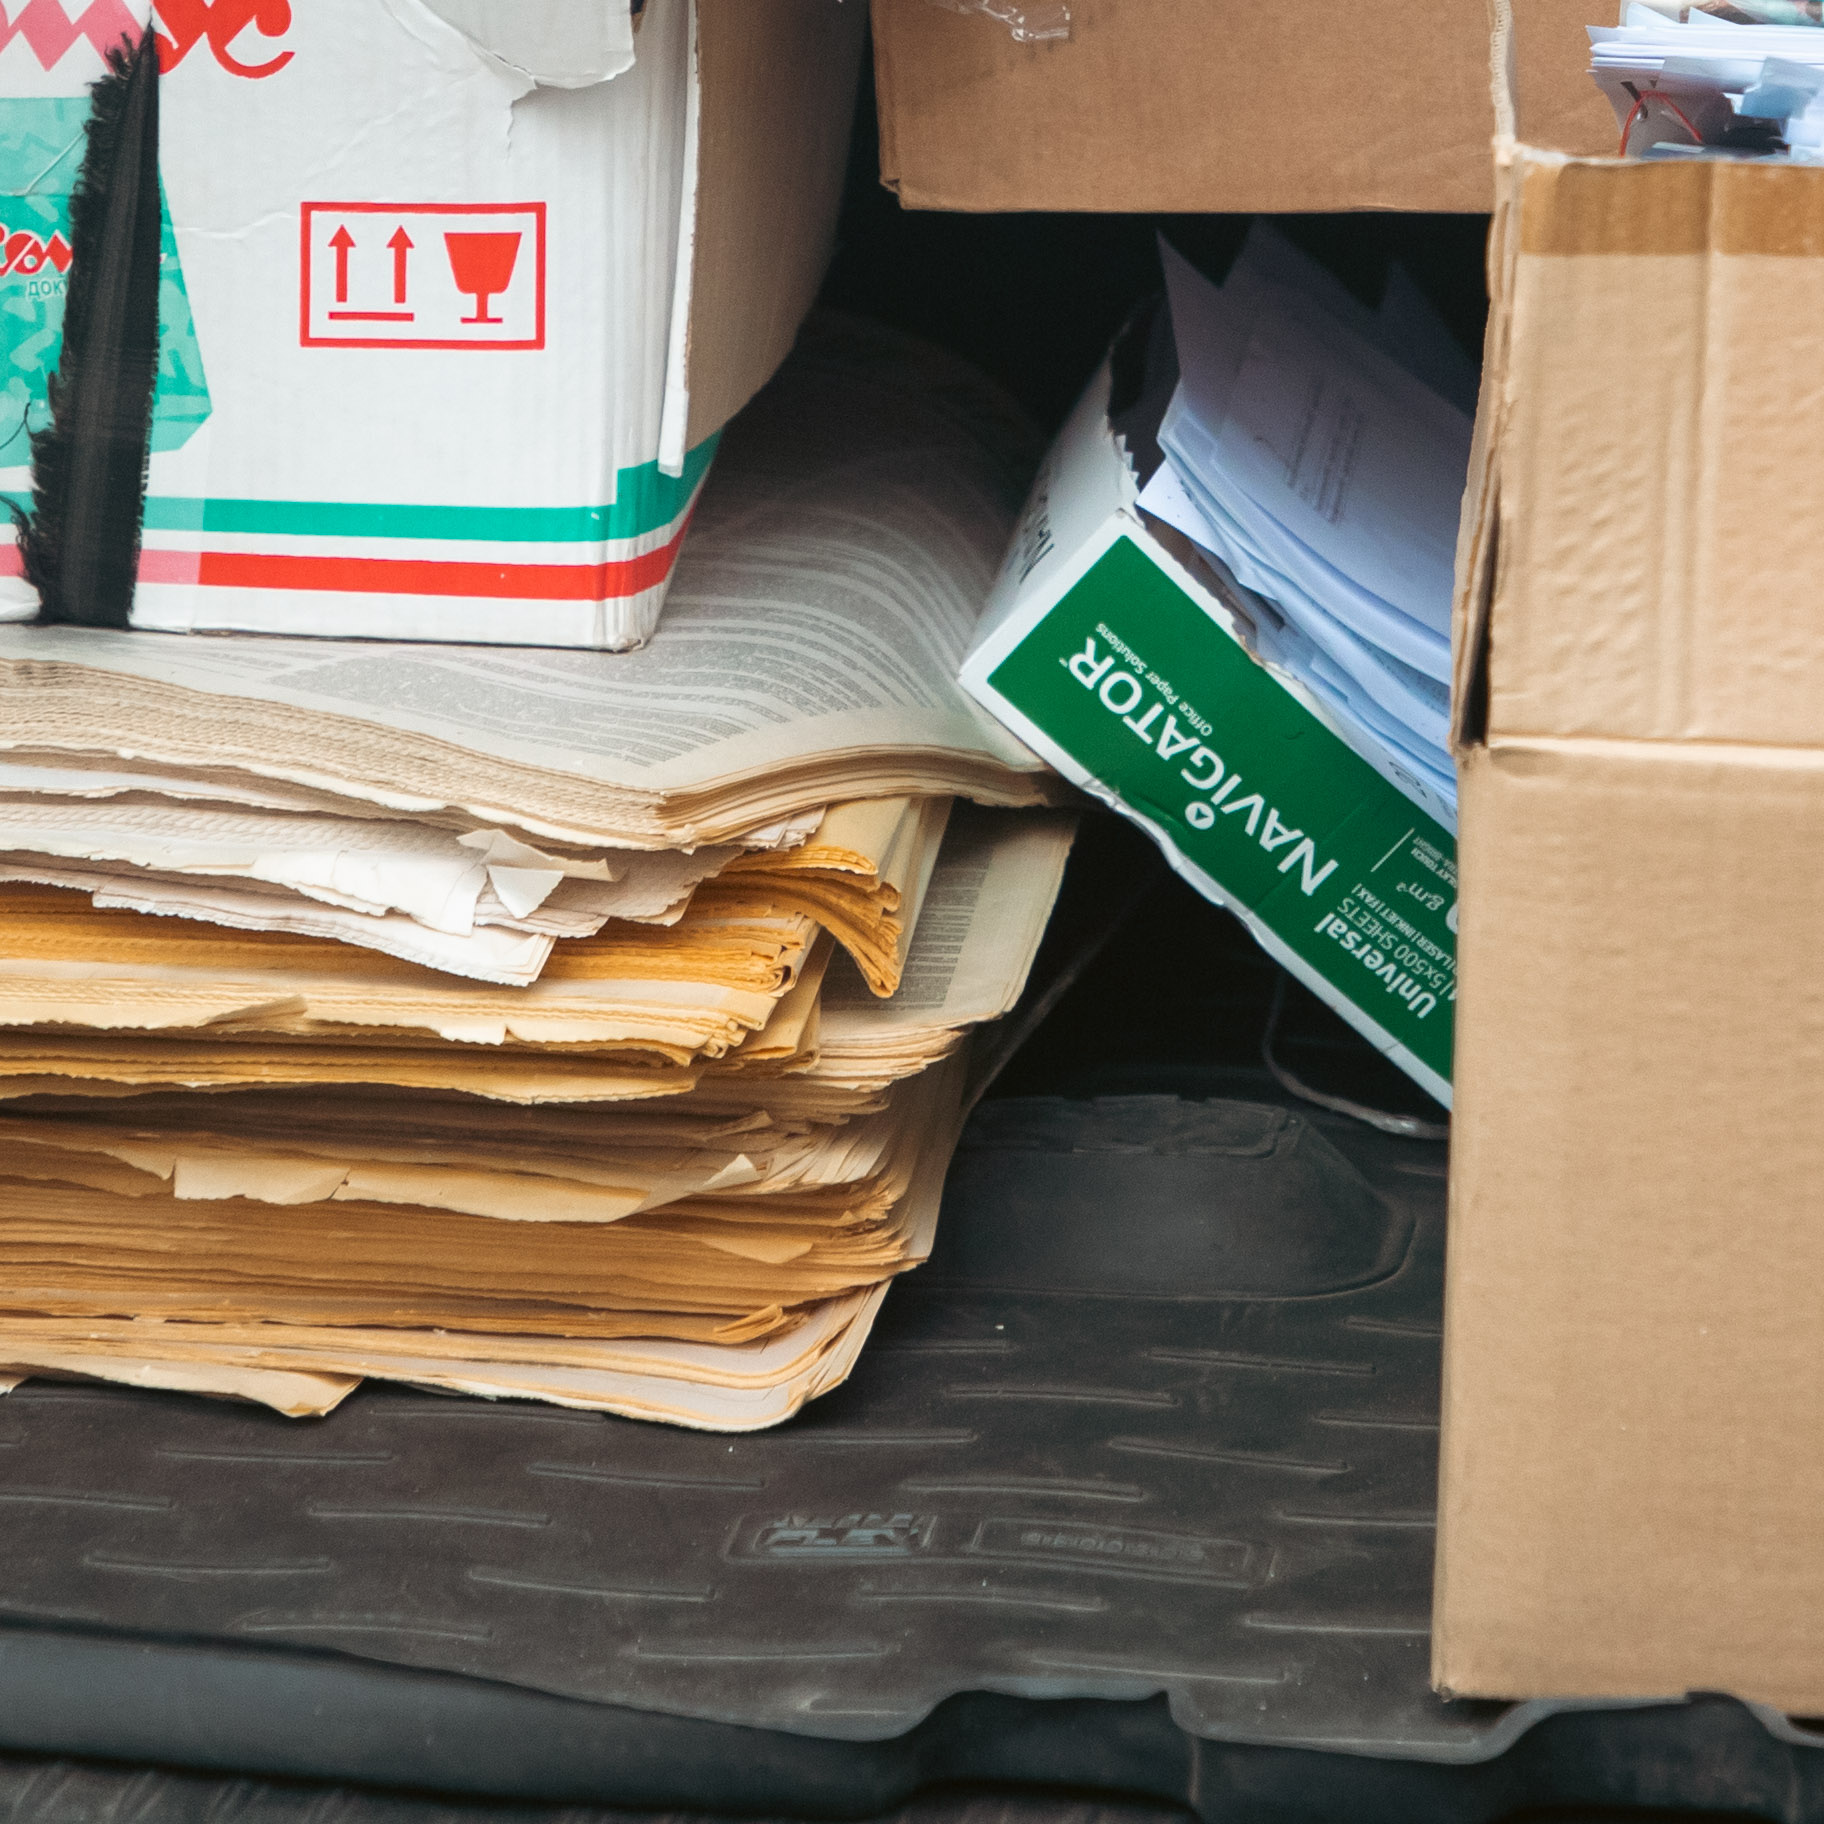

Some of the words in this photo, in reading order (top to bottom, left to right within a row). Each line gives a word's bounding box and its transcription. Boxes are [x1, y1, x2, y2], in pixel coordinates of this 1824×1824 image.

[1095, 622, 1150, 676] Solutions
[1144, 671, 1182, 707] Paper
[1178, 701, 1214, 738] Office
[1065, 638, 1339, 897] NAVIGATOR
[1338, 898, 1400, 952] SHEETS
[1315, 914, 1437, 1020] Universal
[1394, 944, 1447, 990] 5x500
